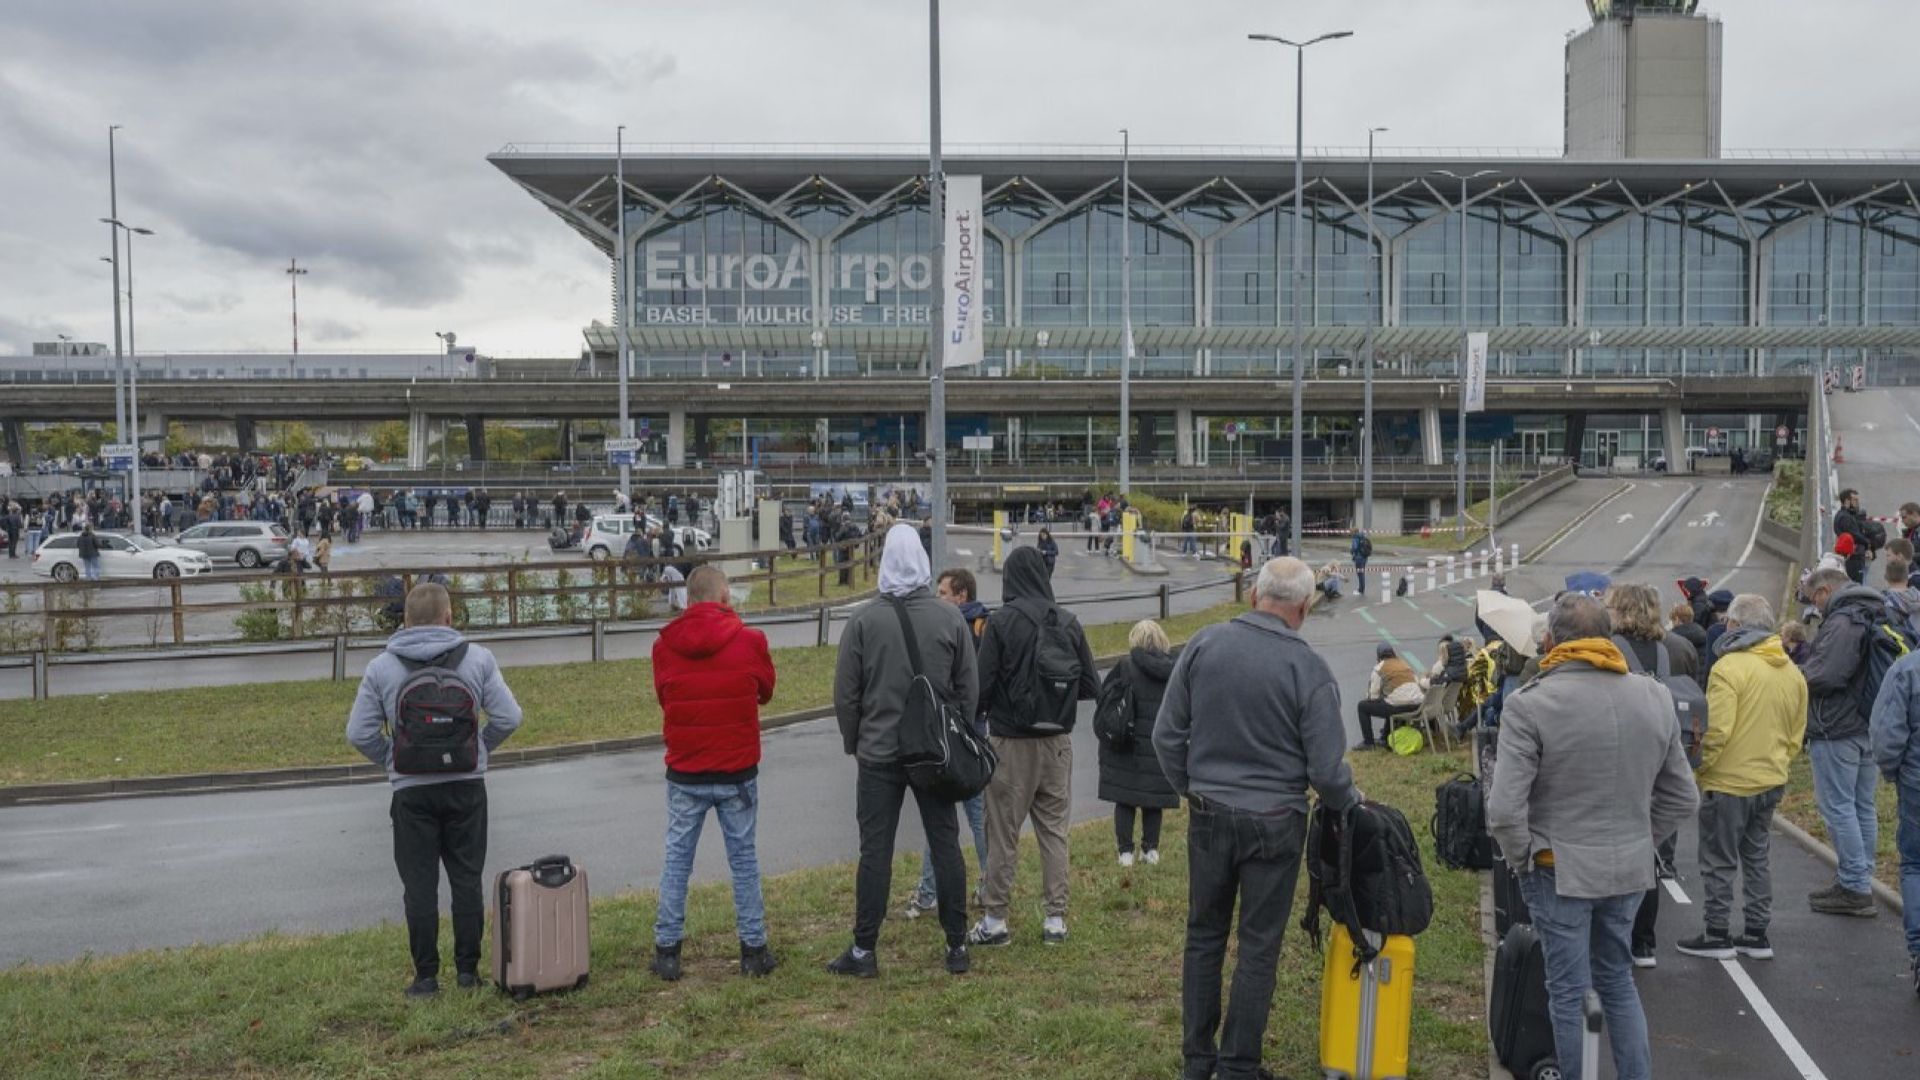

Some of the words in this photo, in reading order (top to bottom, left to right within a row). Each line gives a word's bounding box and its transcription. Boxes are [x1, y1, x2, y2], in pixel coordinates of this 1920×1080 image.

[647, 242, 993, 301] EuroArpo.
[647, 307, 718, 323] BASEL
[737, 307, 863, 323] MULHOSE
[883, 307, 993, 323] FREIG
